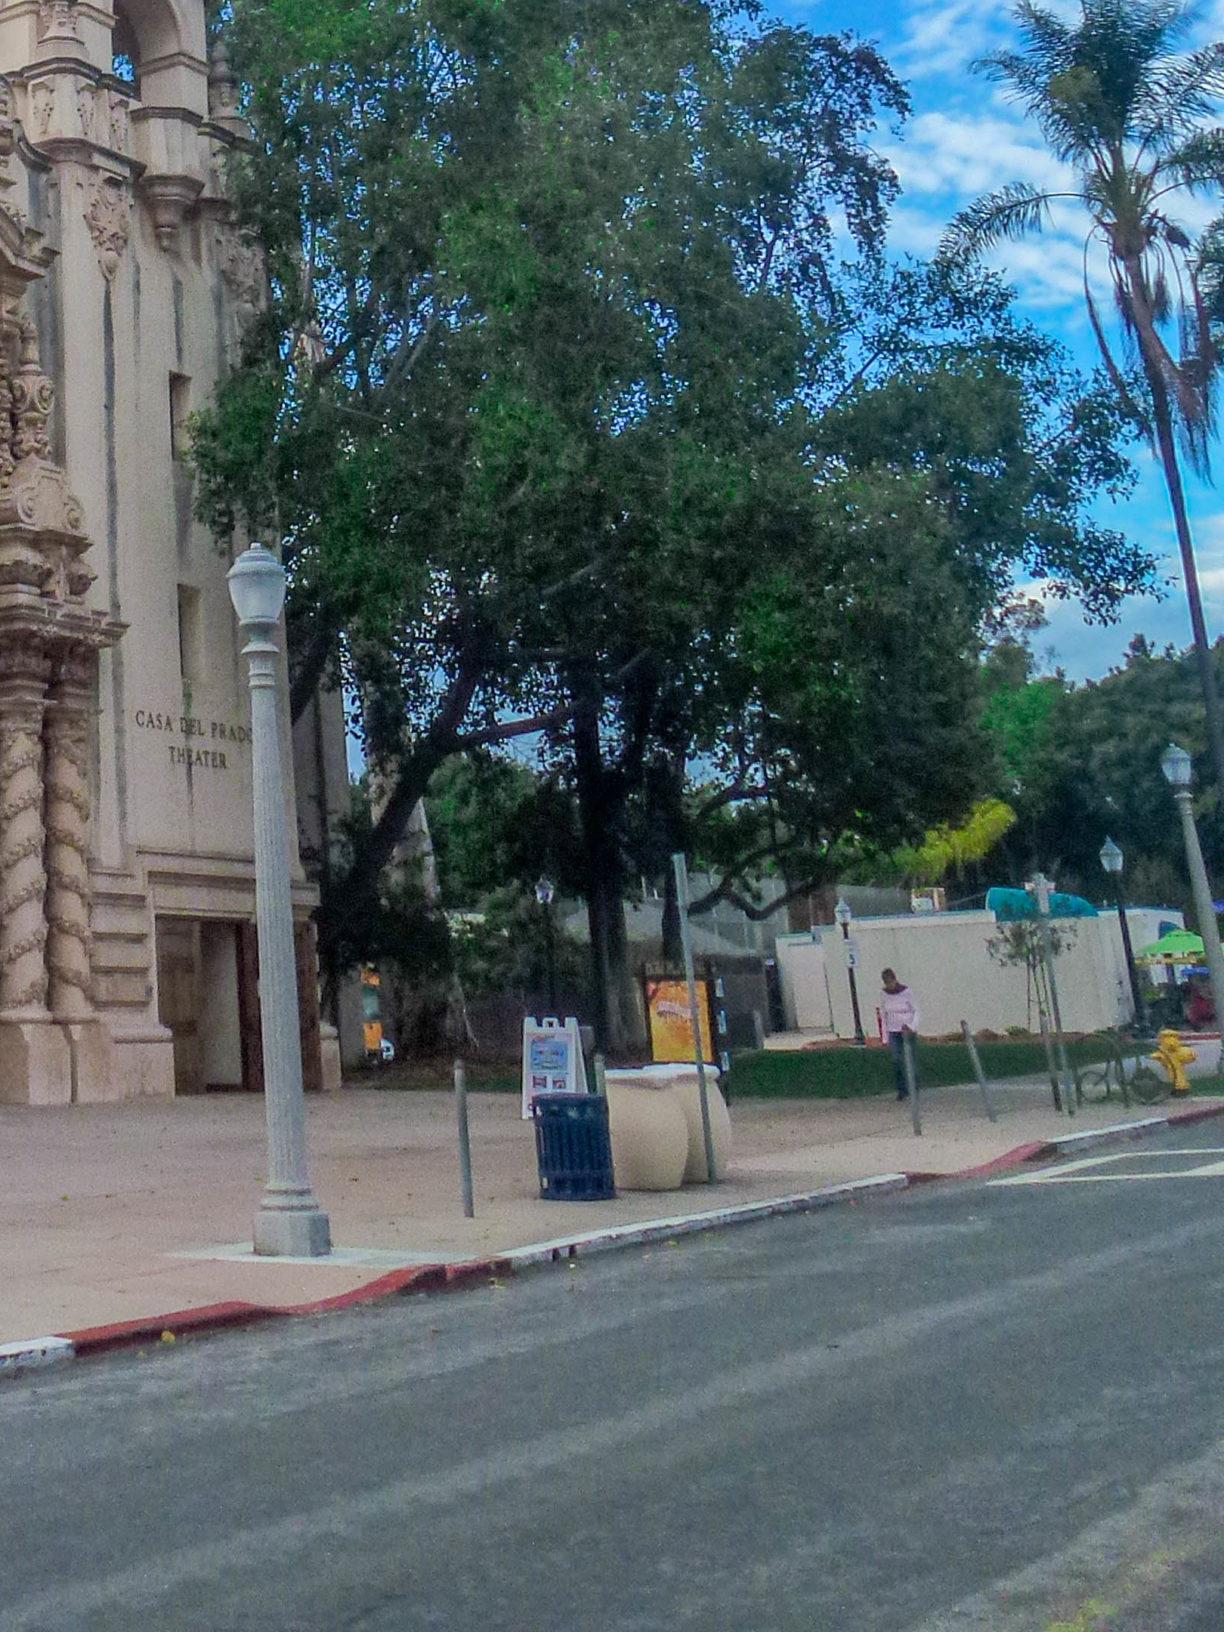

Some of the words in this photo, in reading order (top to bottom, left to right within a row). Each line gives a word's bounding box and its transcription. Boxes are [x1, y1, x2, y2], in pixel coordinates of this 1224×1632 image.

[136, 710, 173, 732] CASA
[179, 716, 204, 736] DEL
[168, 746, 227, 769] THEATER
